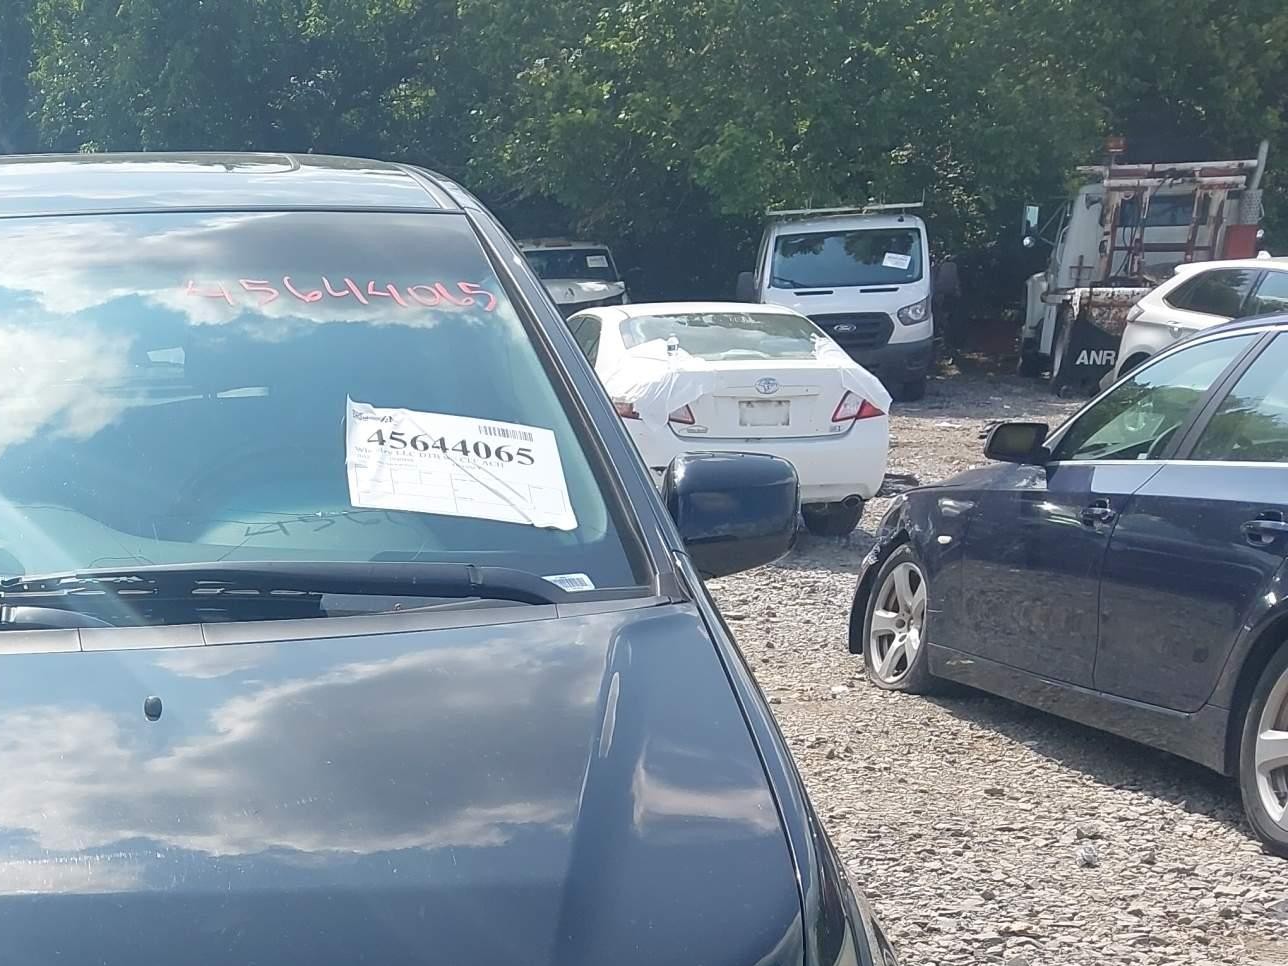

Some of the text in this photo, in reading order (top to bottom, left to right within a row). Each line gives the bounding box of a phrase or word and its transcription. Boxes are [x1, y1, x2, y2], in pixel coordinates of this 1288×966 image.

[184, 276, 497, 313] 45644065
[1075, 350, 1117, 365] ANR
[367, 428, 535, 466] 45644065
